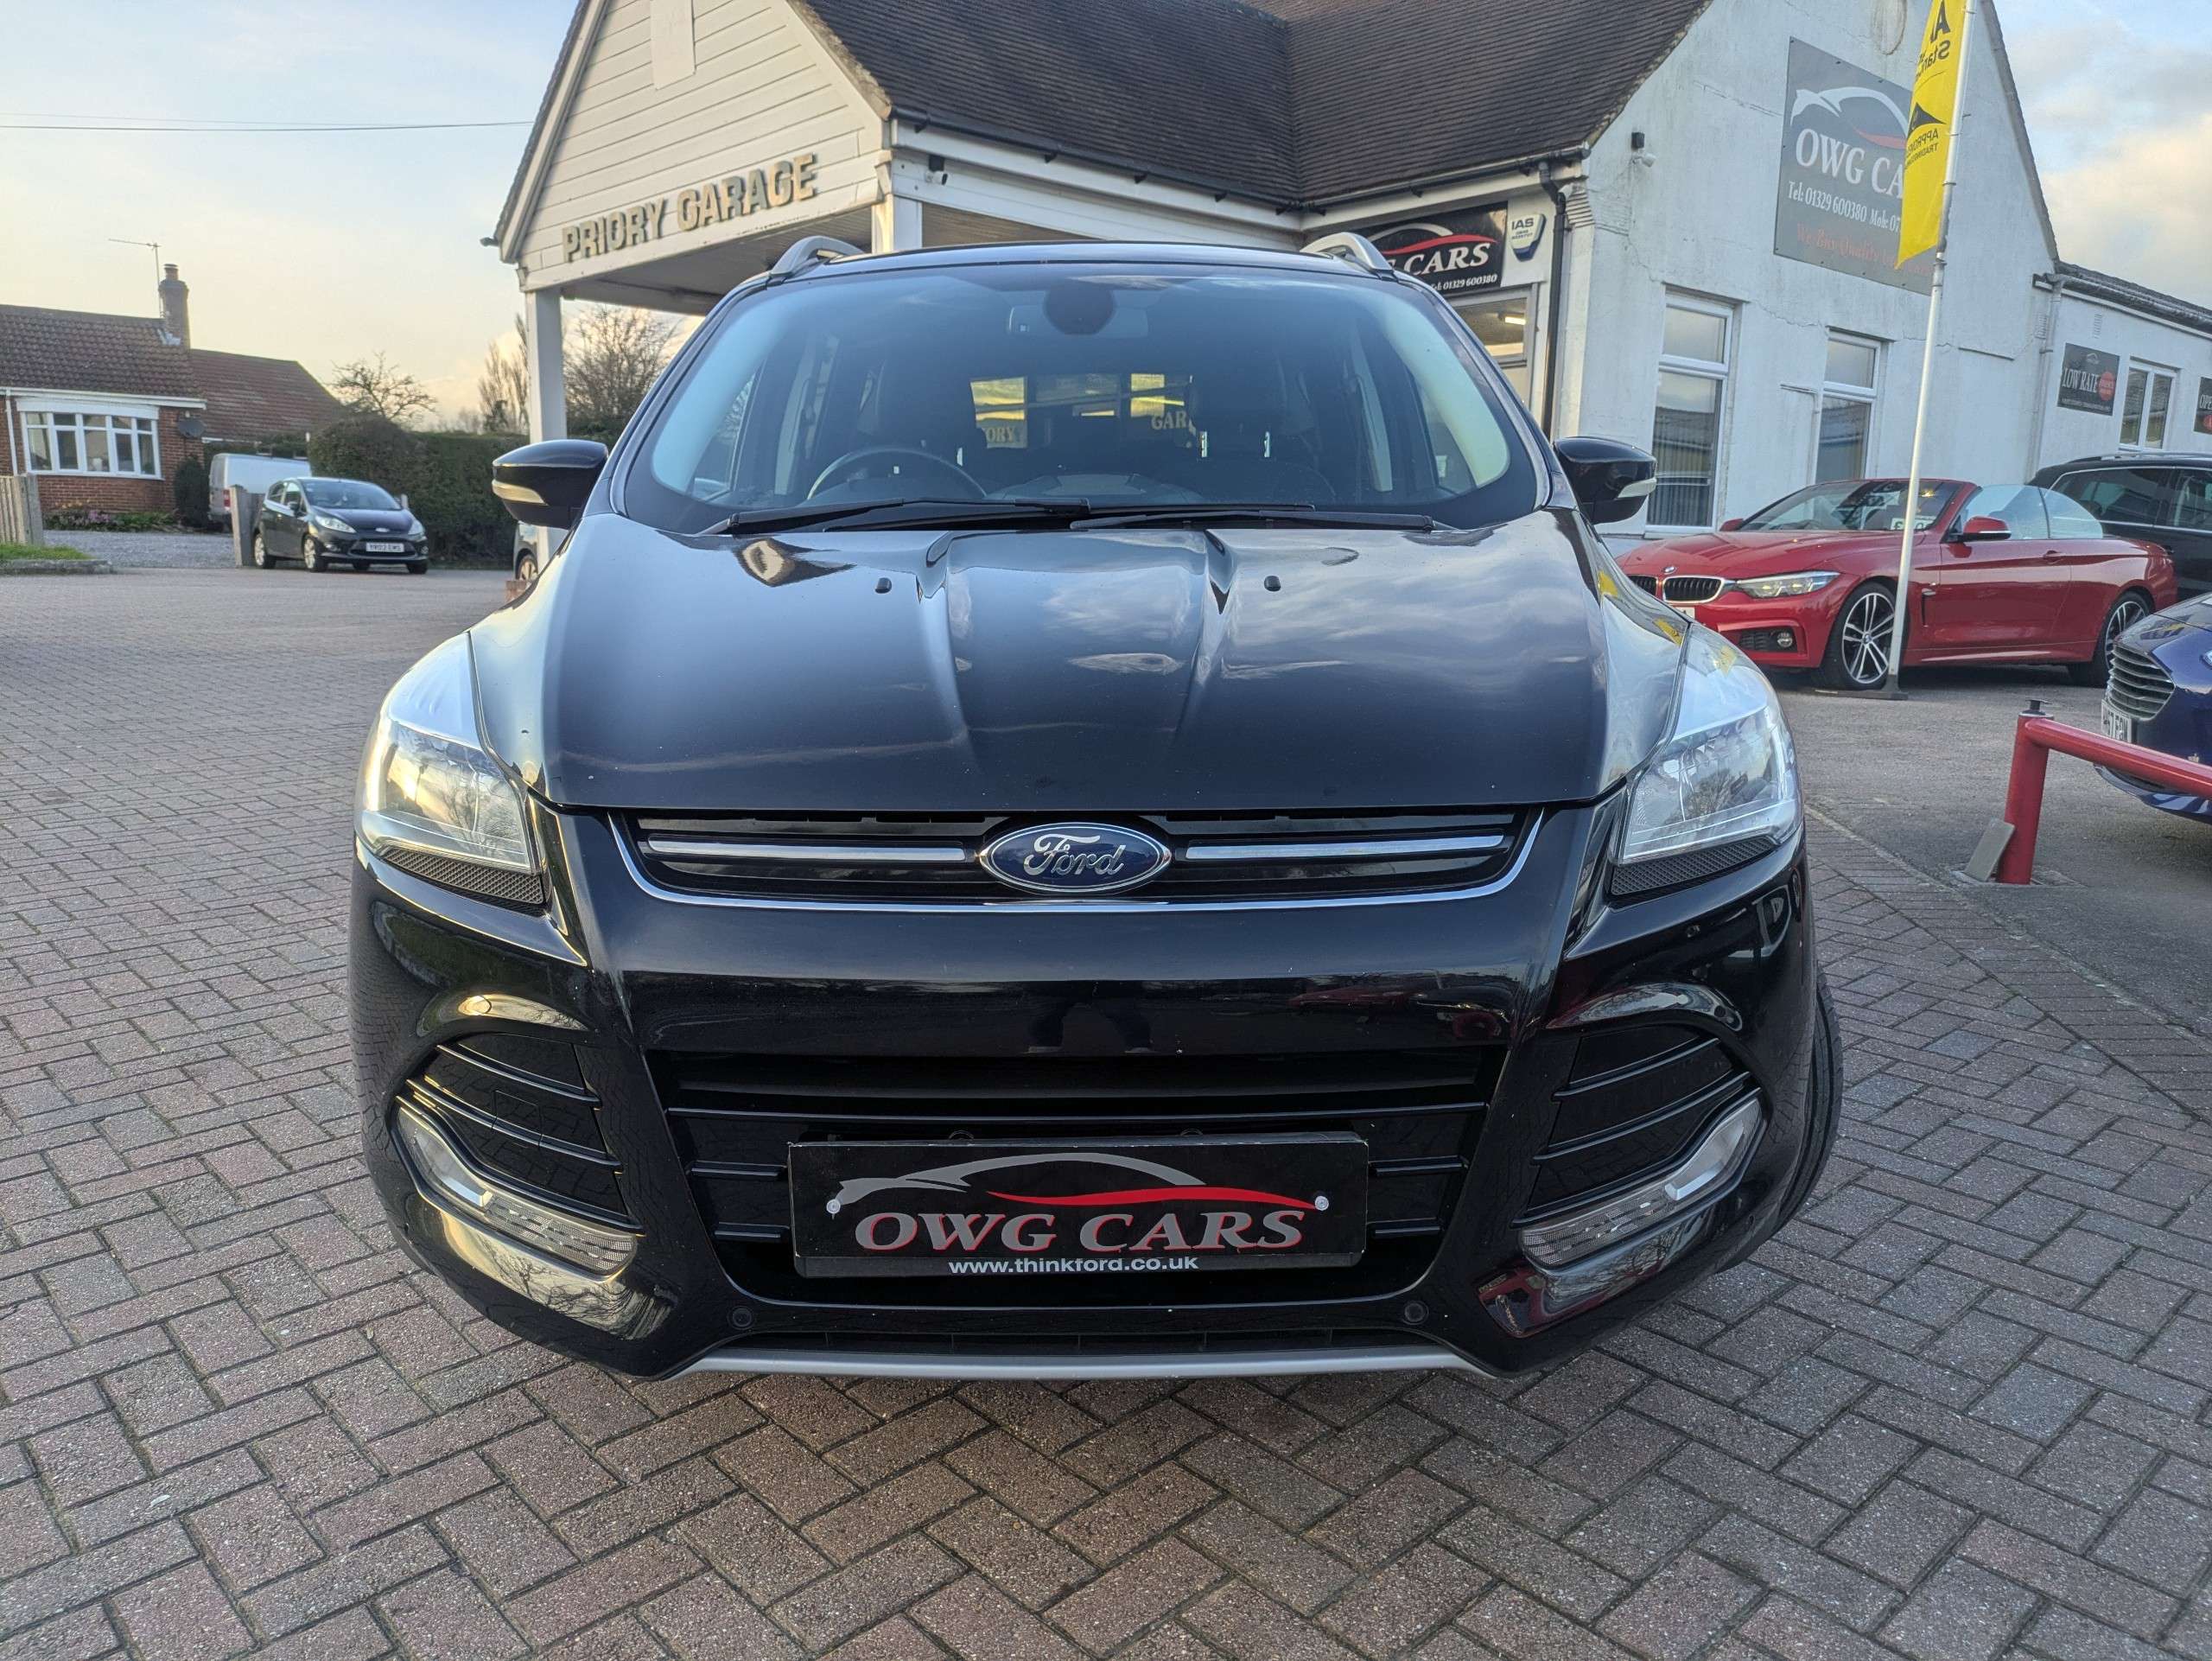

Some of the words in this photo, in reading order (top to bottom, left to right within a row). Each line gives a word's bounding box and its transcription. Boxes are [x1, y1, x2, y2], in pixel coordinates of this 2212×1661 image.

[1796, 129, 1866, 185] OWG
[1871, 156, 1904, 200] CA
[562, 196, 668, 263] PRIORY
[676, 152, 818, 232] GARAGE
[1788, 181, 1804, 202] Tel:
[1804, 187, 1832, 212] 01329
[1833, 196, 1867, 222] 600380
[1511, 218, 1534, 230] IAS
[1403, 243, 1491, 276] CARS
[1442, 279, 1465, 291] 01329
[1465, 273, 1498, 287] 600380
[2061, 368, 2081, 390] LOW
[984, 426, 1017, 443] ORY
[1023, 833, 1126, 875] Ford
[855, 1211, 1056, 1252] OWG
[1078, 1209, 1306, 1252] CARS
[948, 1256, 1199, 1275] www.thinkford.co.uk
